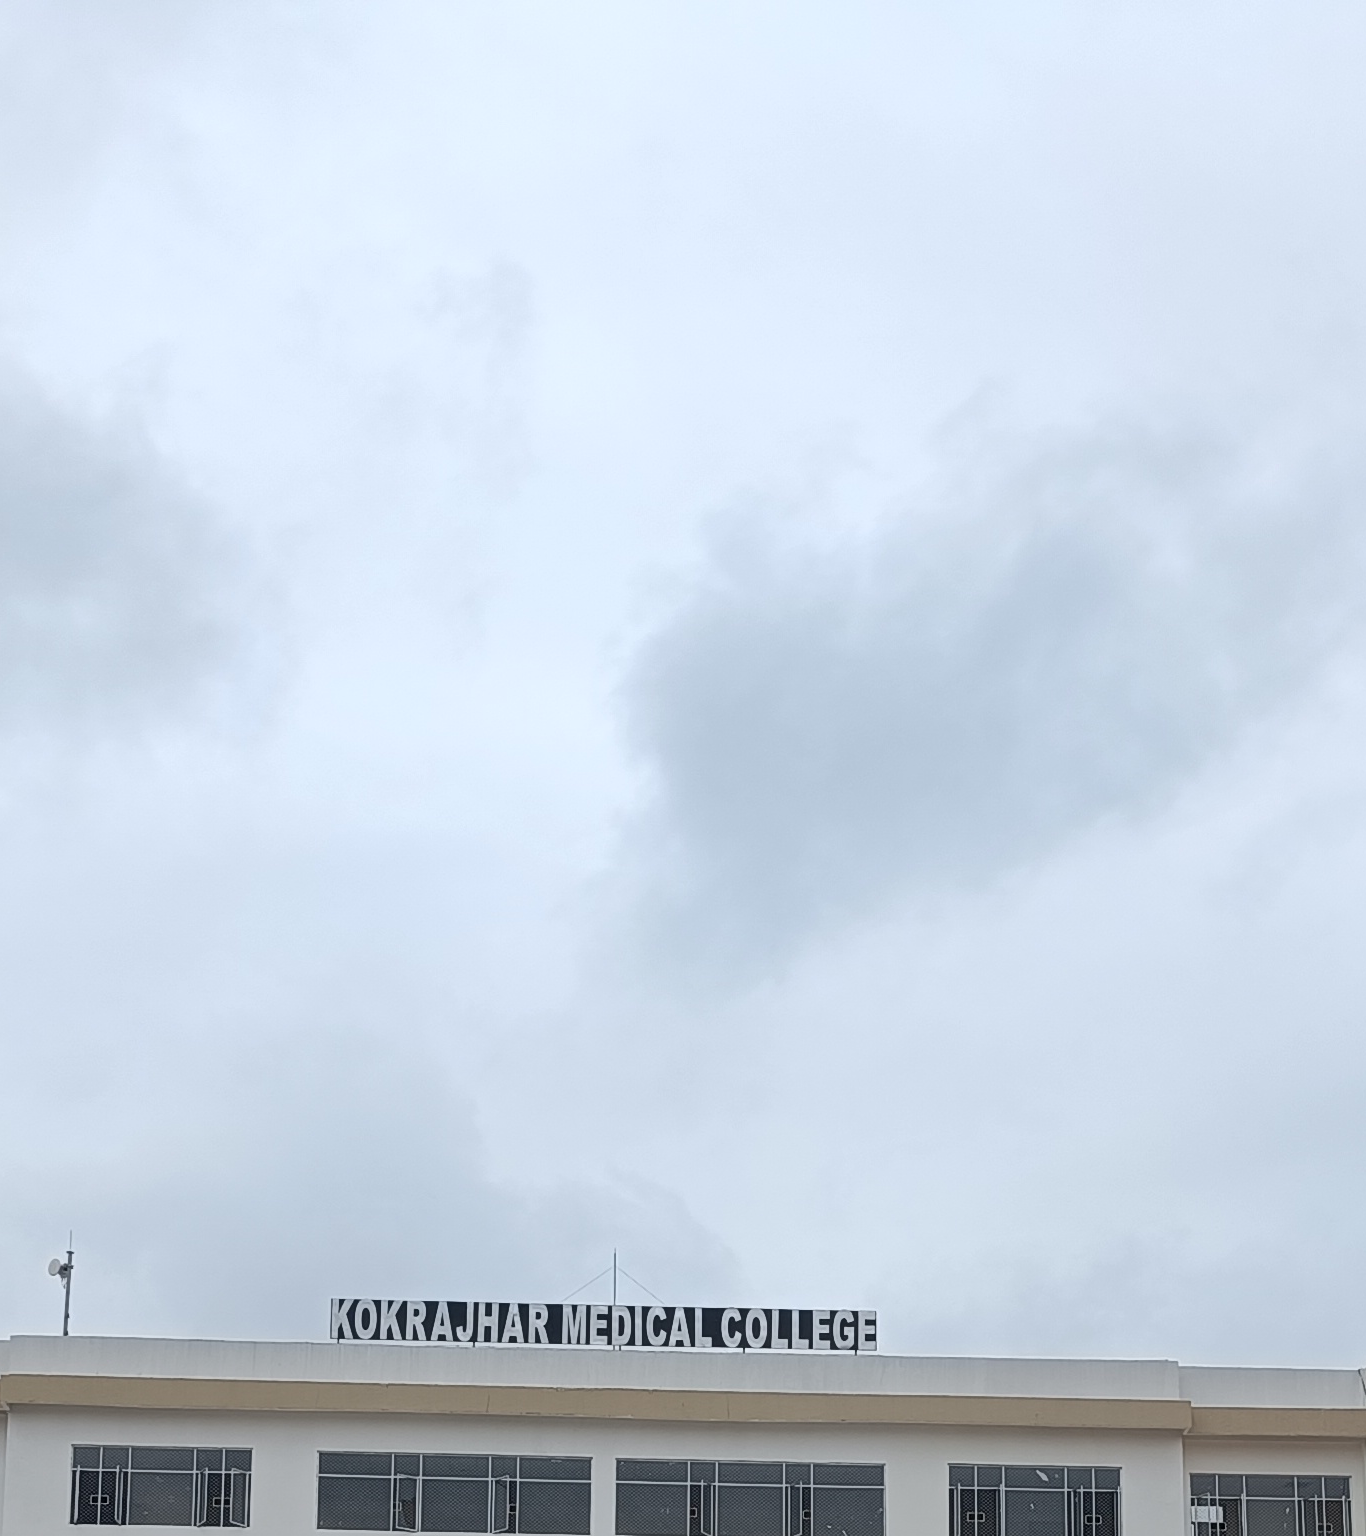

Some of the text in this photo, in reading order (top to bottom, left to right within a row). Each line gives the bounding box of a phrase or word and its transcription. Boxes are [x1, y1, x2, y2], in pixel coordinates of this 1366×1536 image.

[331, 1298, 876, 1351] KOKRAJHAR MEDICAL COLLEGE
